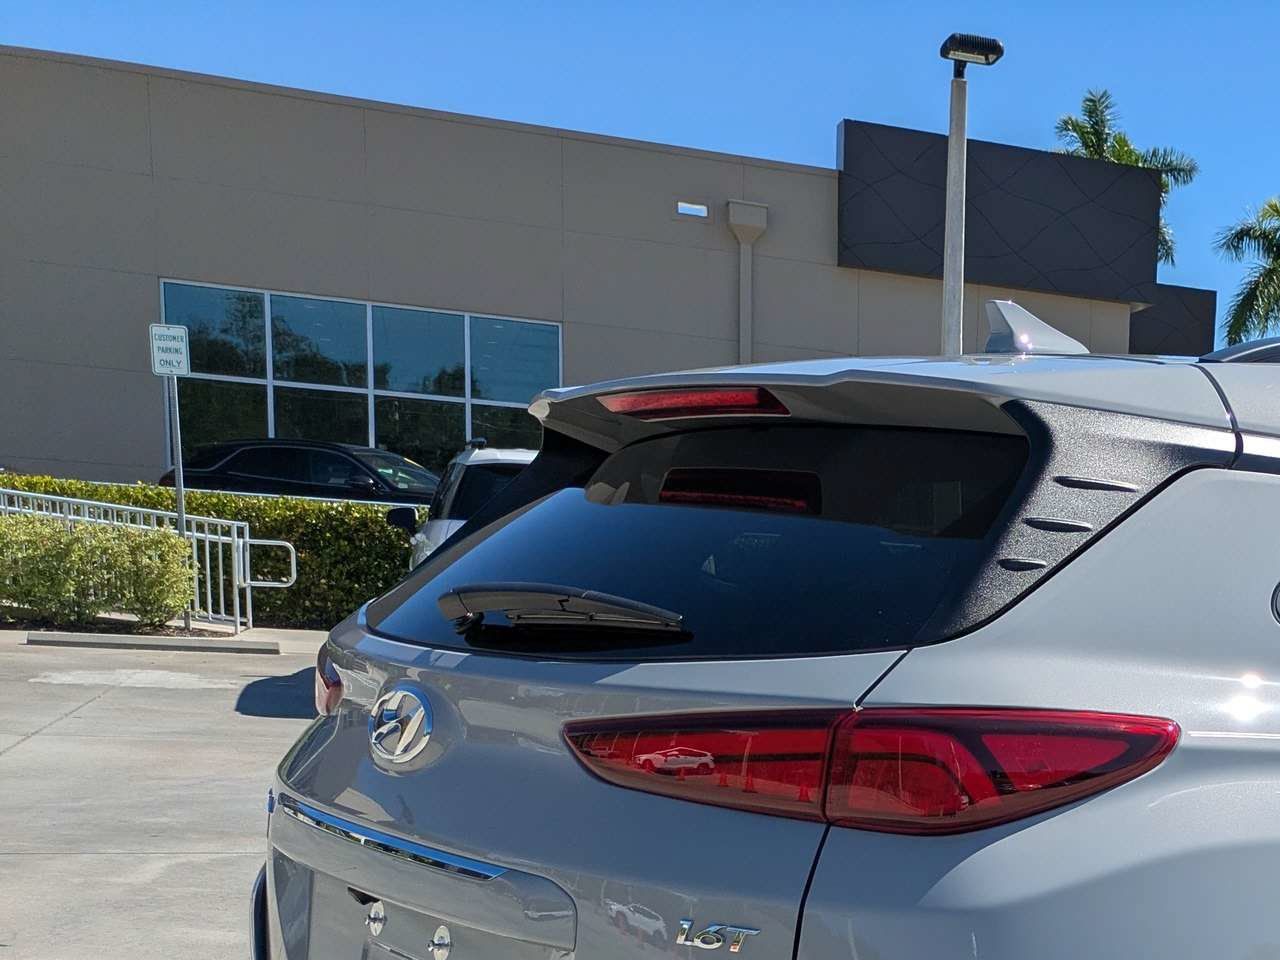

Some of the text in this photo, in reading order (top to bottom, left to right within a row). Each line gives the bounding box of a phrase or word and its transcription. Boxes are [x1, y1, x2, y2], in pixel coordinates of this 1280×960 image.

[154, 333, 185, 343] CUSTOMER
[157, 346, 182, 354] PARKING
[159, 359, 182, 368] ONLY
